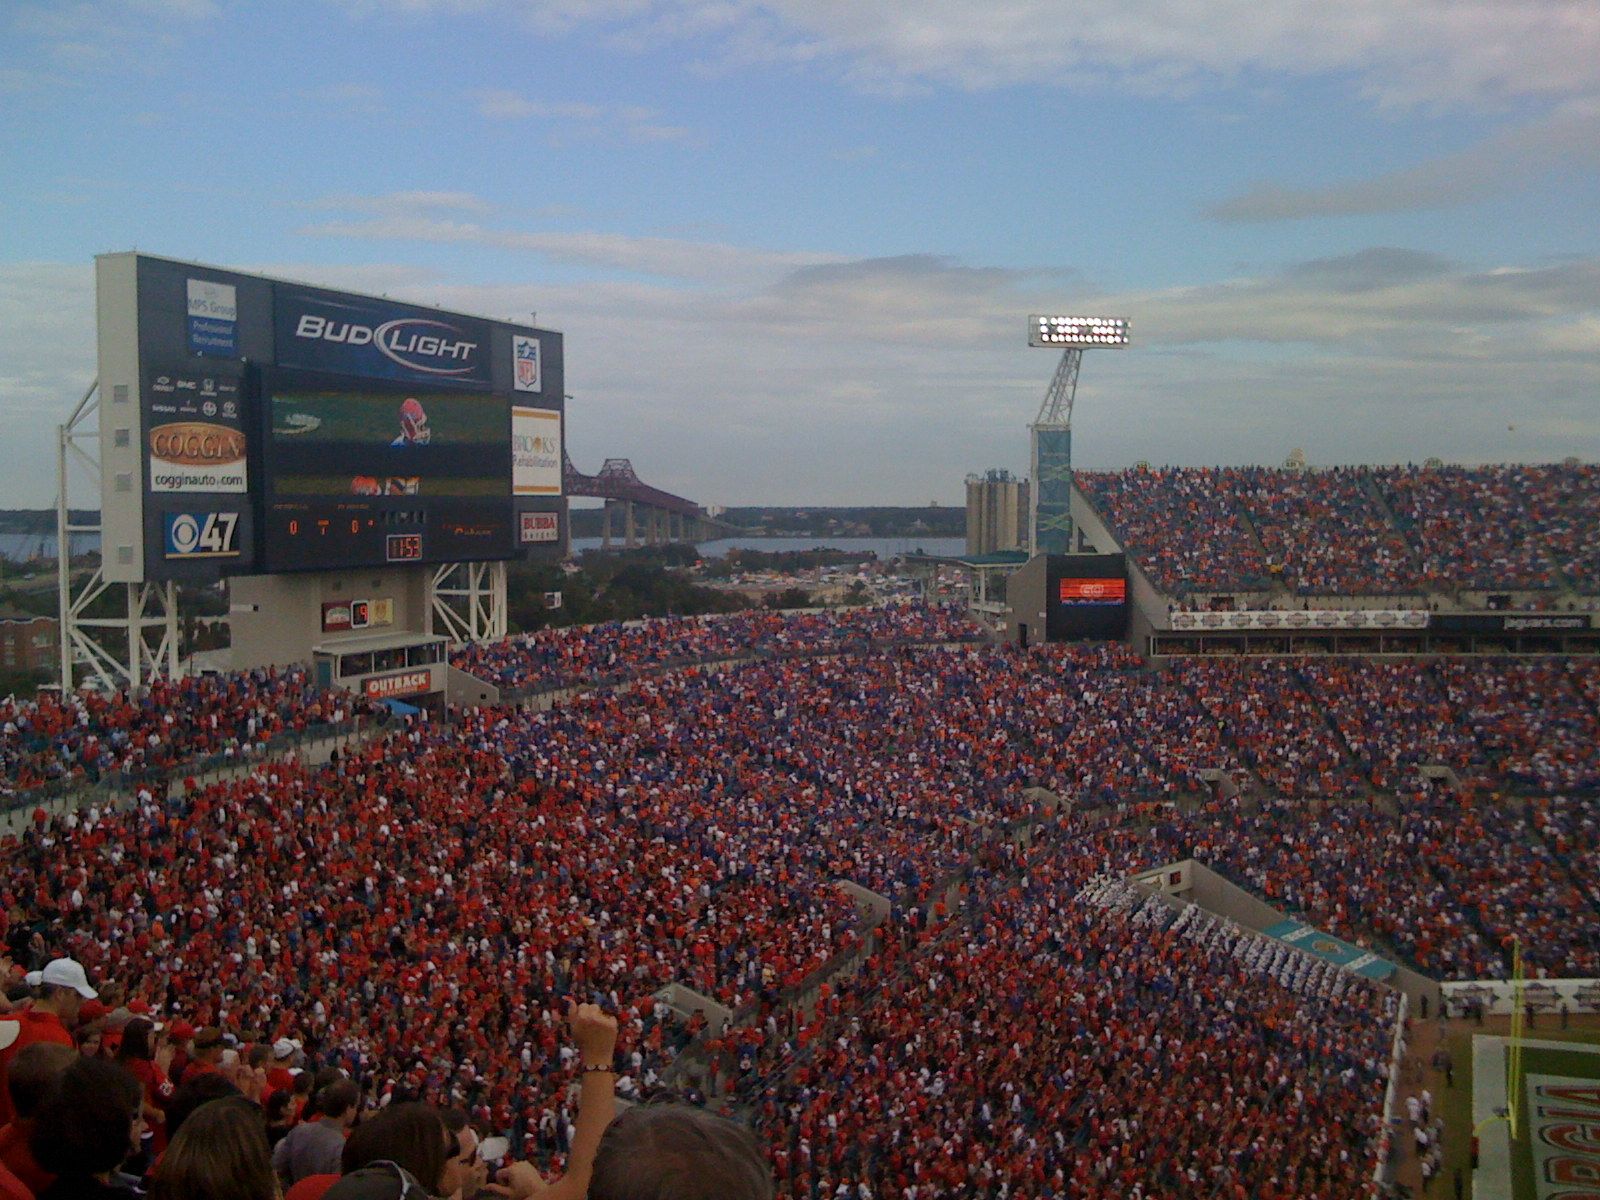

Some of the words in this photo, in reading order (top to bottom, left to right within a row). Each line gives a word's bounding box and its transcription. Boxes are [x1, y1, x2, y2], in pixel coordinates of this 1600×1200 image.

[153, 432, 243, 459] COGGIN
[155, 473, 243, 489] cogginauto.com
[200, 511, 239, 552] 47
[523, 517, 556, 530] BUBBA
[370, 673, 426, 692] OUTBACK
